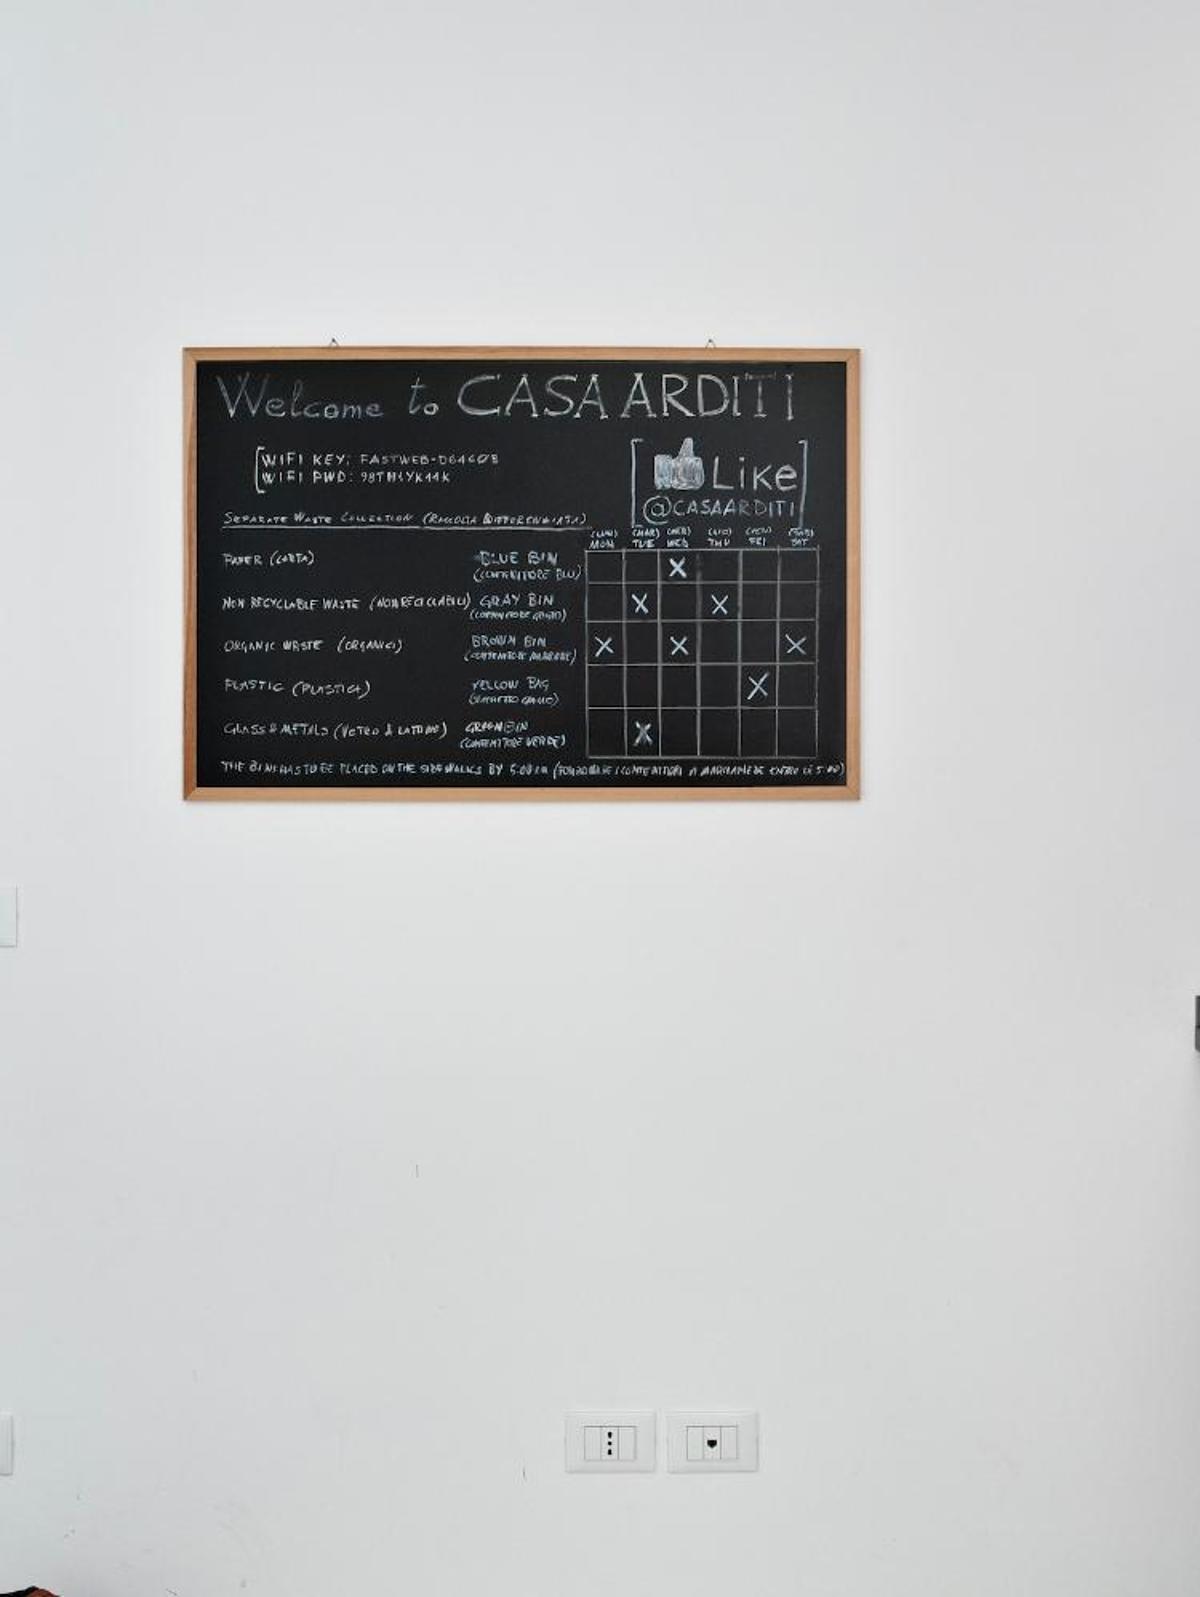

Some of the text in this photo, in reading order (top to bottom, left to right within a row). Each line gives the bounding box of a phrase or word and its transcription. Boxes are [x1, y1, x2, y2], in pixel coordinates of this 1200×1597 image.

[217, 372, 795, 421] Welcome to CASA ARDITI
[261, 453, 303, 467] WIFI
[261, 470, 303, 484] WIFI
[712, 455, 798, 492] Like
[643, 495, 795, 525] @CASAARDITI
[631, 538, 656, 548] TUE
[527, 551, 558, 566] BIN
[528, 592, 555, 608] BIN
[524, 635, 547, 649] BIN
[526, 676, 550, 692] BAG
